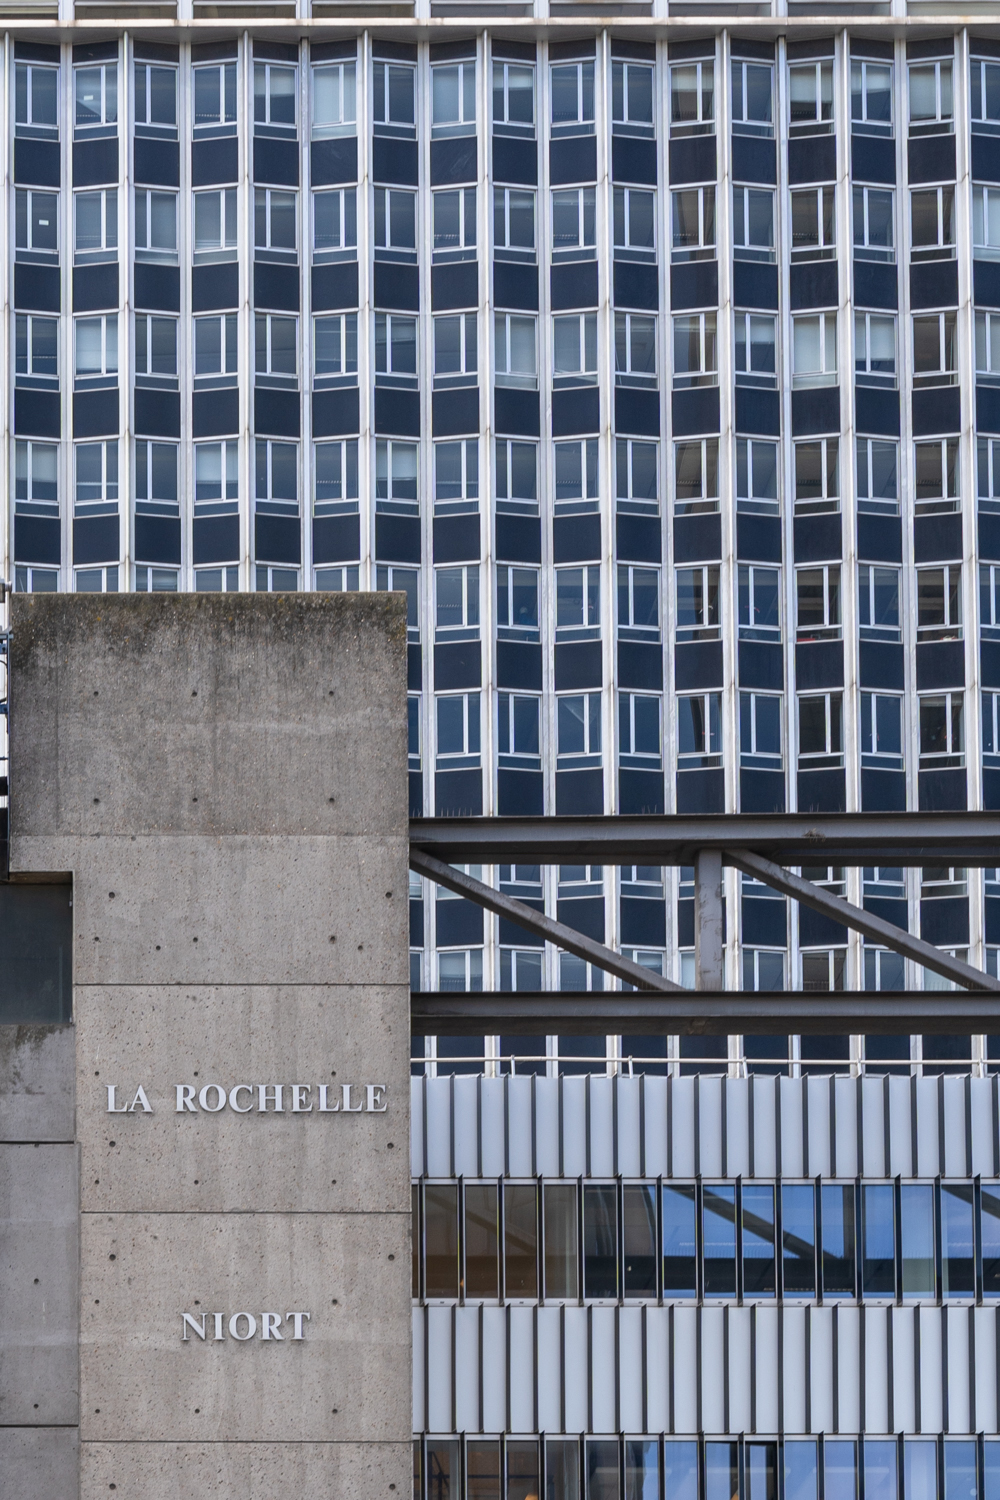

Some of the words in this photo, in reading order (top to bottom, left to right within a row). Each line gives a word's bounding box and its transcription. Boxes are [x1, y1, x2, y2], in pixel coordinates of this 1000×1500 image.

[105, 1084, 153, 1113] LA
[174, 1084, 388, 1113] ROCHELLE
[181, 1312, 311, 1341] NIORT
